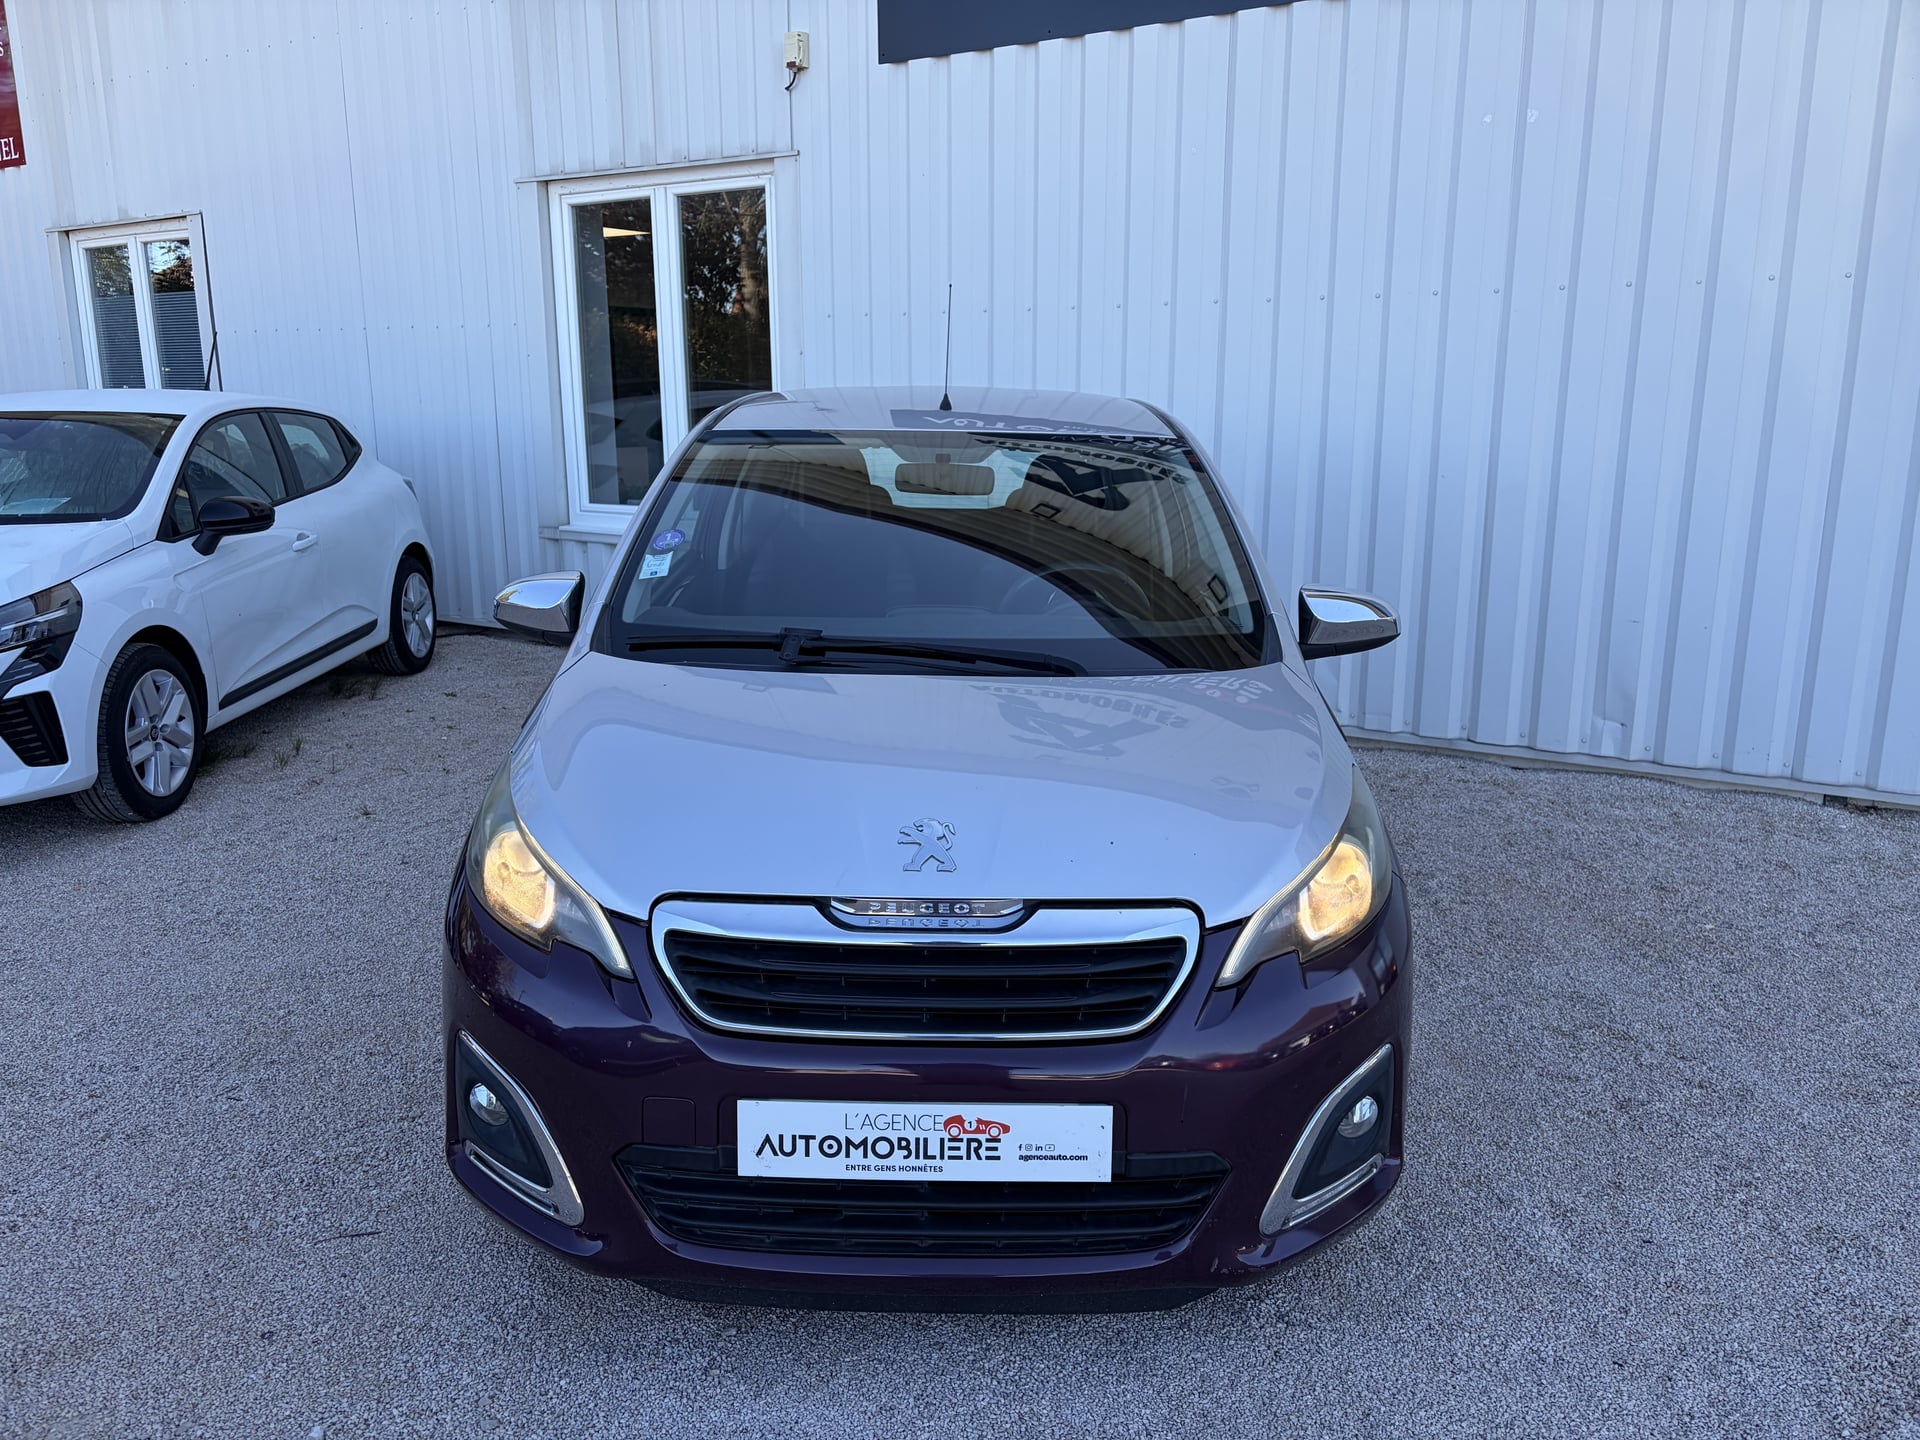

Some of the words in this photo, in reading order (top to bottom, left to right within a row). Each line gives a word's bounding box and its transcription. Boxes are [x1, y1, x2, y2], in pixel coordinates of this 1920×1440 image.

[0, 137, 20, 162] EL
[868, 902, 986, 914] PEUGEOT
[844, 1112, 945, 1132] L'AGENCE
[1018, 1153, 1088, 1162] agenceauto.com
[845, 1164, 872, 1172] ENTRE
[873, 1164, 897, 1172] GENS
[898, 1163, 944, 1173] HONNÊTES
